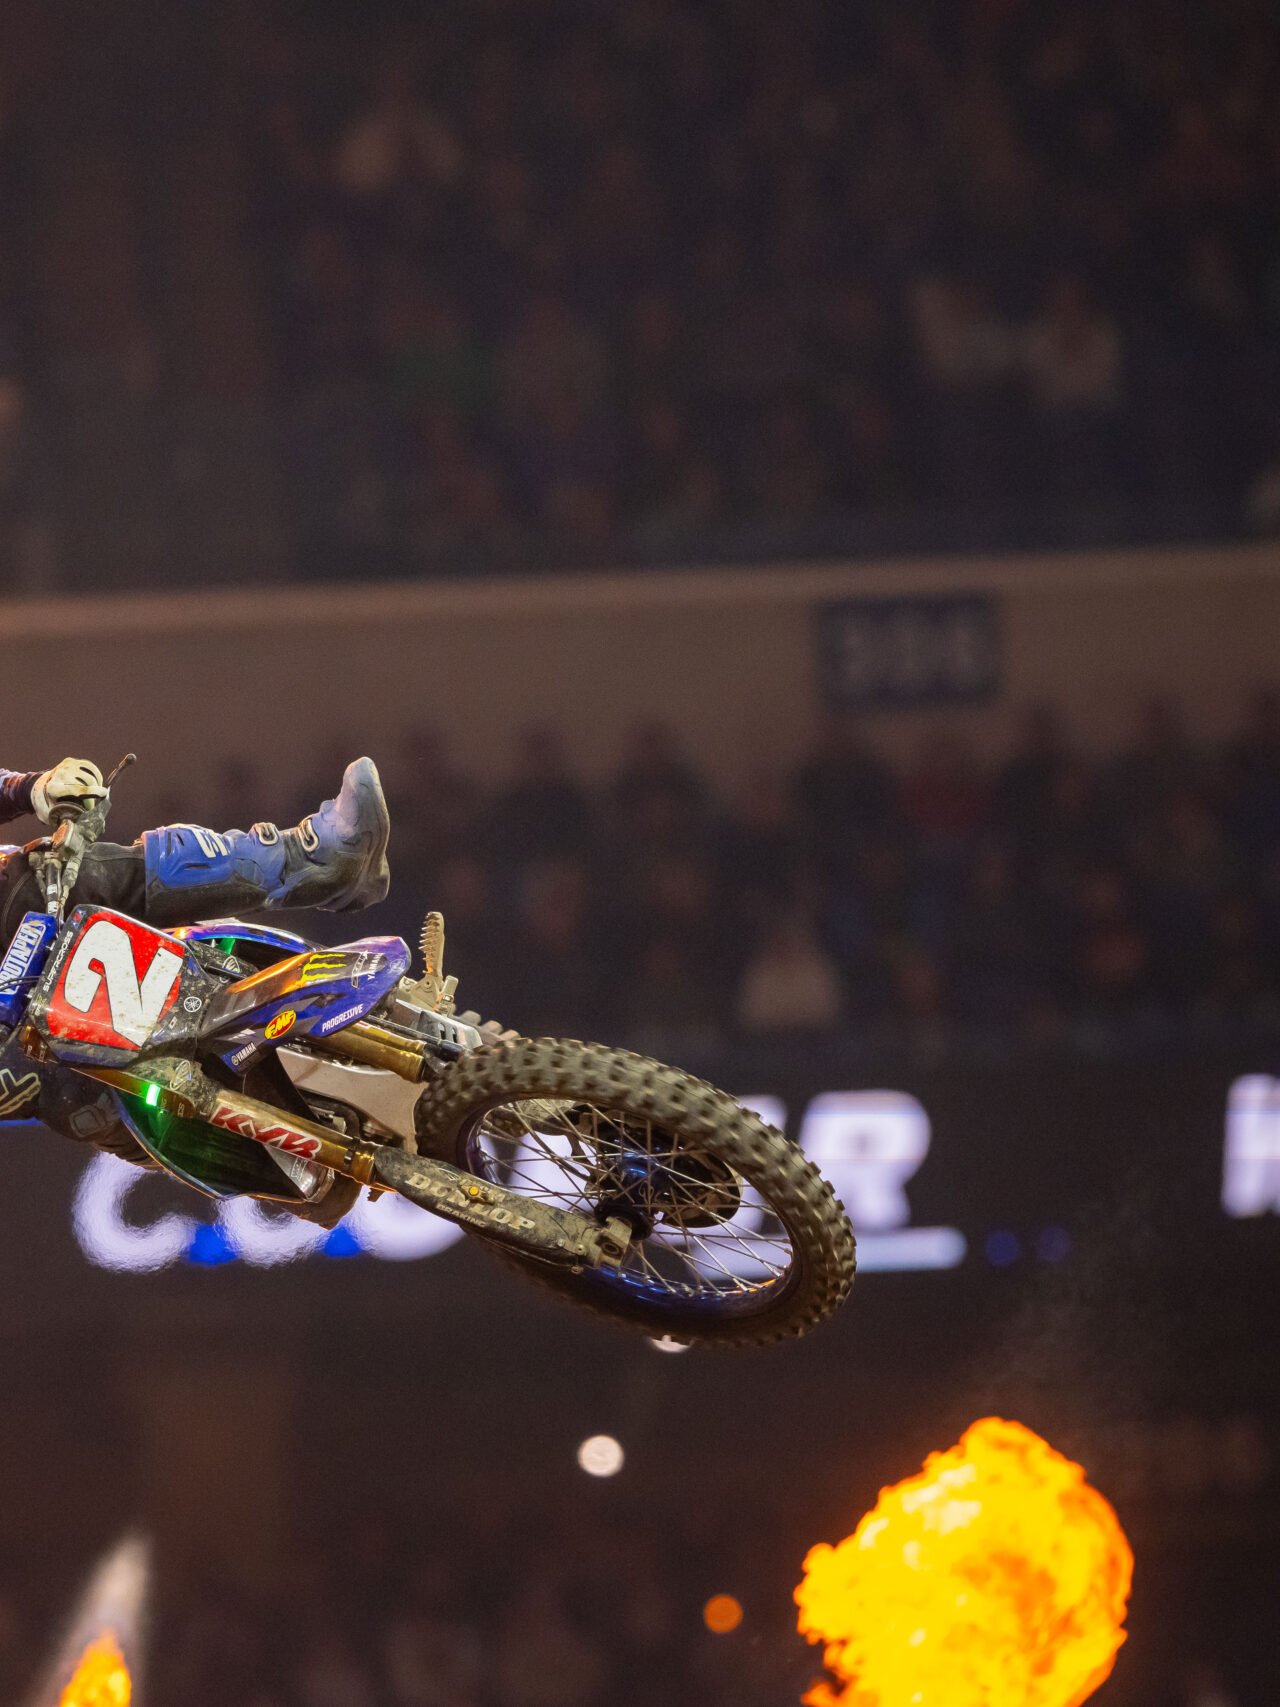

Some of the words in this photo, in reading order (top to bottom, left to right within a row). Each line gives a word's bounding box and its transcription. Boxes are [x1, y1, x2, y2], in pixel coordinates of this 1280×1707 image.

[64, 919, 184, 1048] 2
[264, 1009, 296, 1040] FMF
[321, 1003, 365, 1033] PROGRESSIVE
[235, 1041, 258, 1063] YAMAHA
[209, 1104, 323, 1160] KYB
[404, 1171, 537, 1231] DUNLOP
